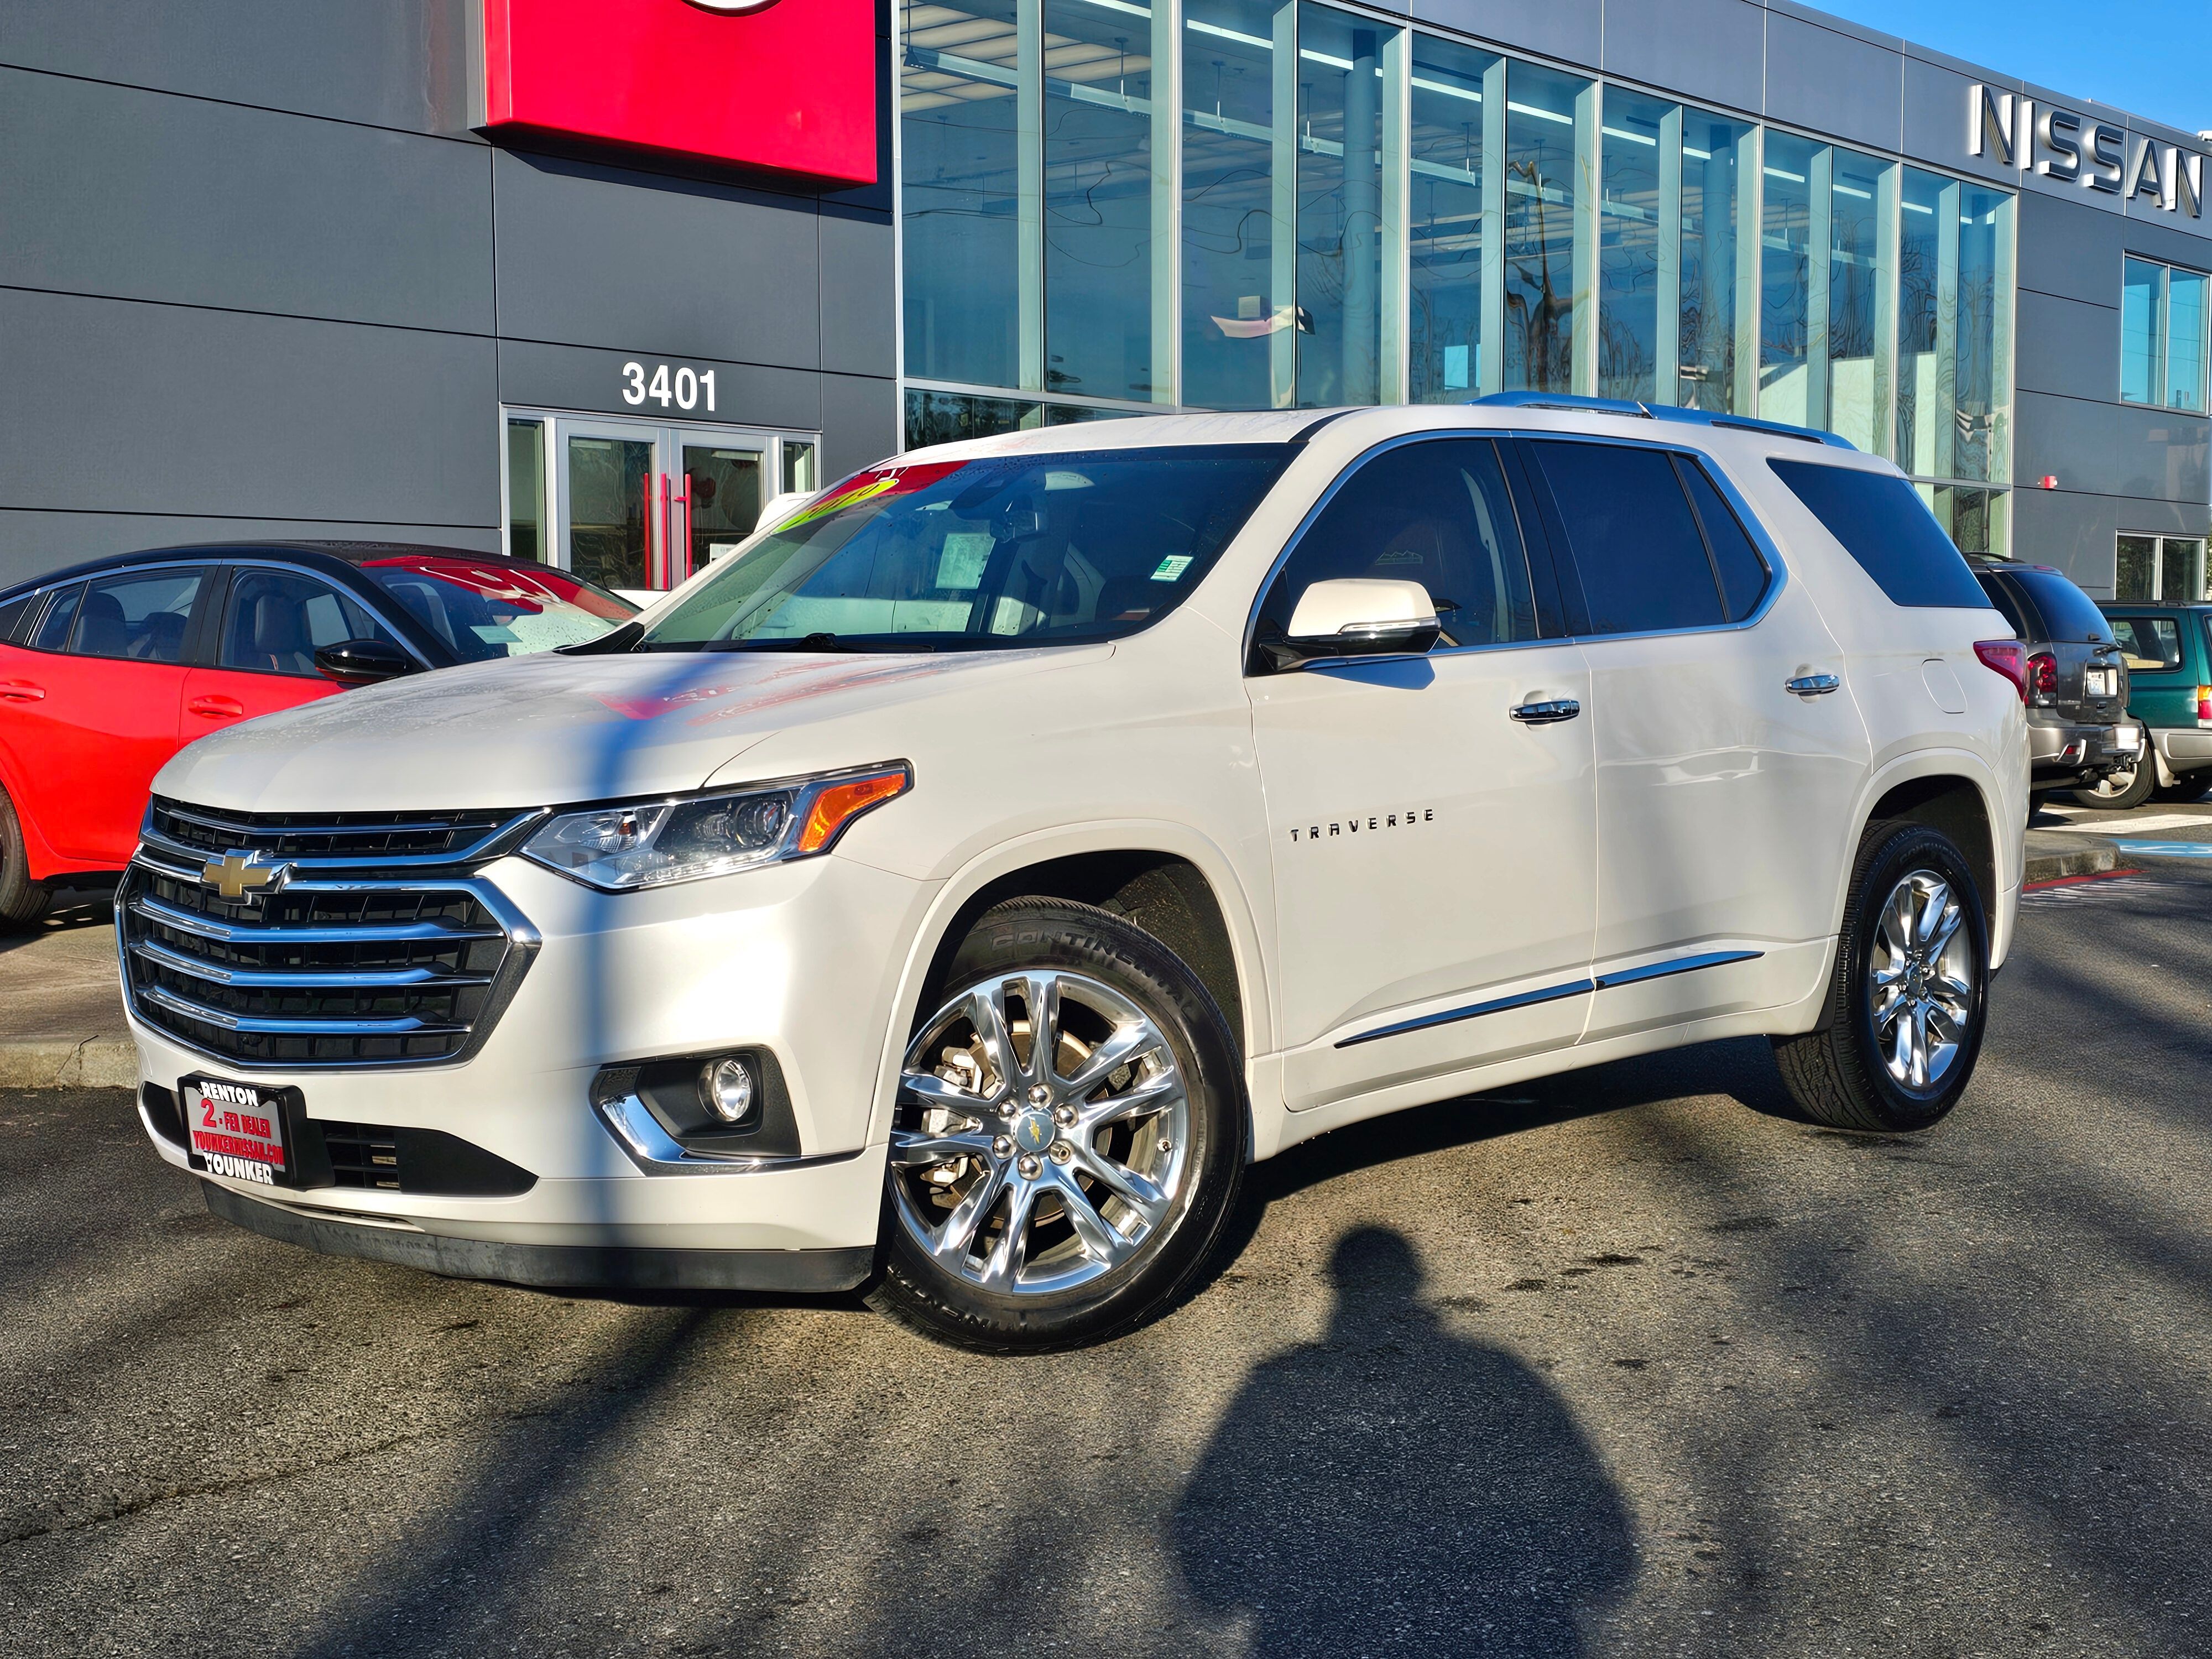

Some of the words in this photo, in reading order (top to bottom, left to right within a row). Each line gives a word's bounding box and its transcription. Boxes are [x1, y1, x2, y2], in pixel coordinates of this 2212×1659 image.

[1969, 84, 2203, 218] NISSAN
[622, 362, 715, 411] 3401
[1288, 808, 1434, 842] TRAVERSE
[200, 1081, 259, 1107] RENTON
[241, 1114, 272, 1139] DEALER
[203, 1152, 274, 1185] YOUNKER
